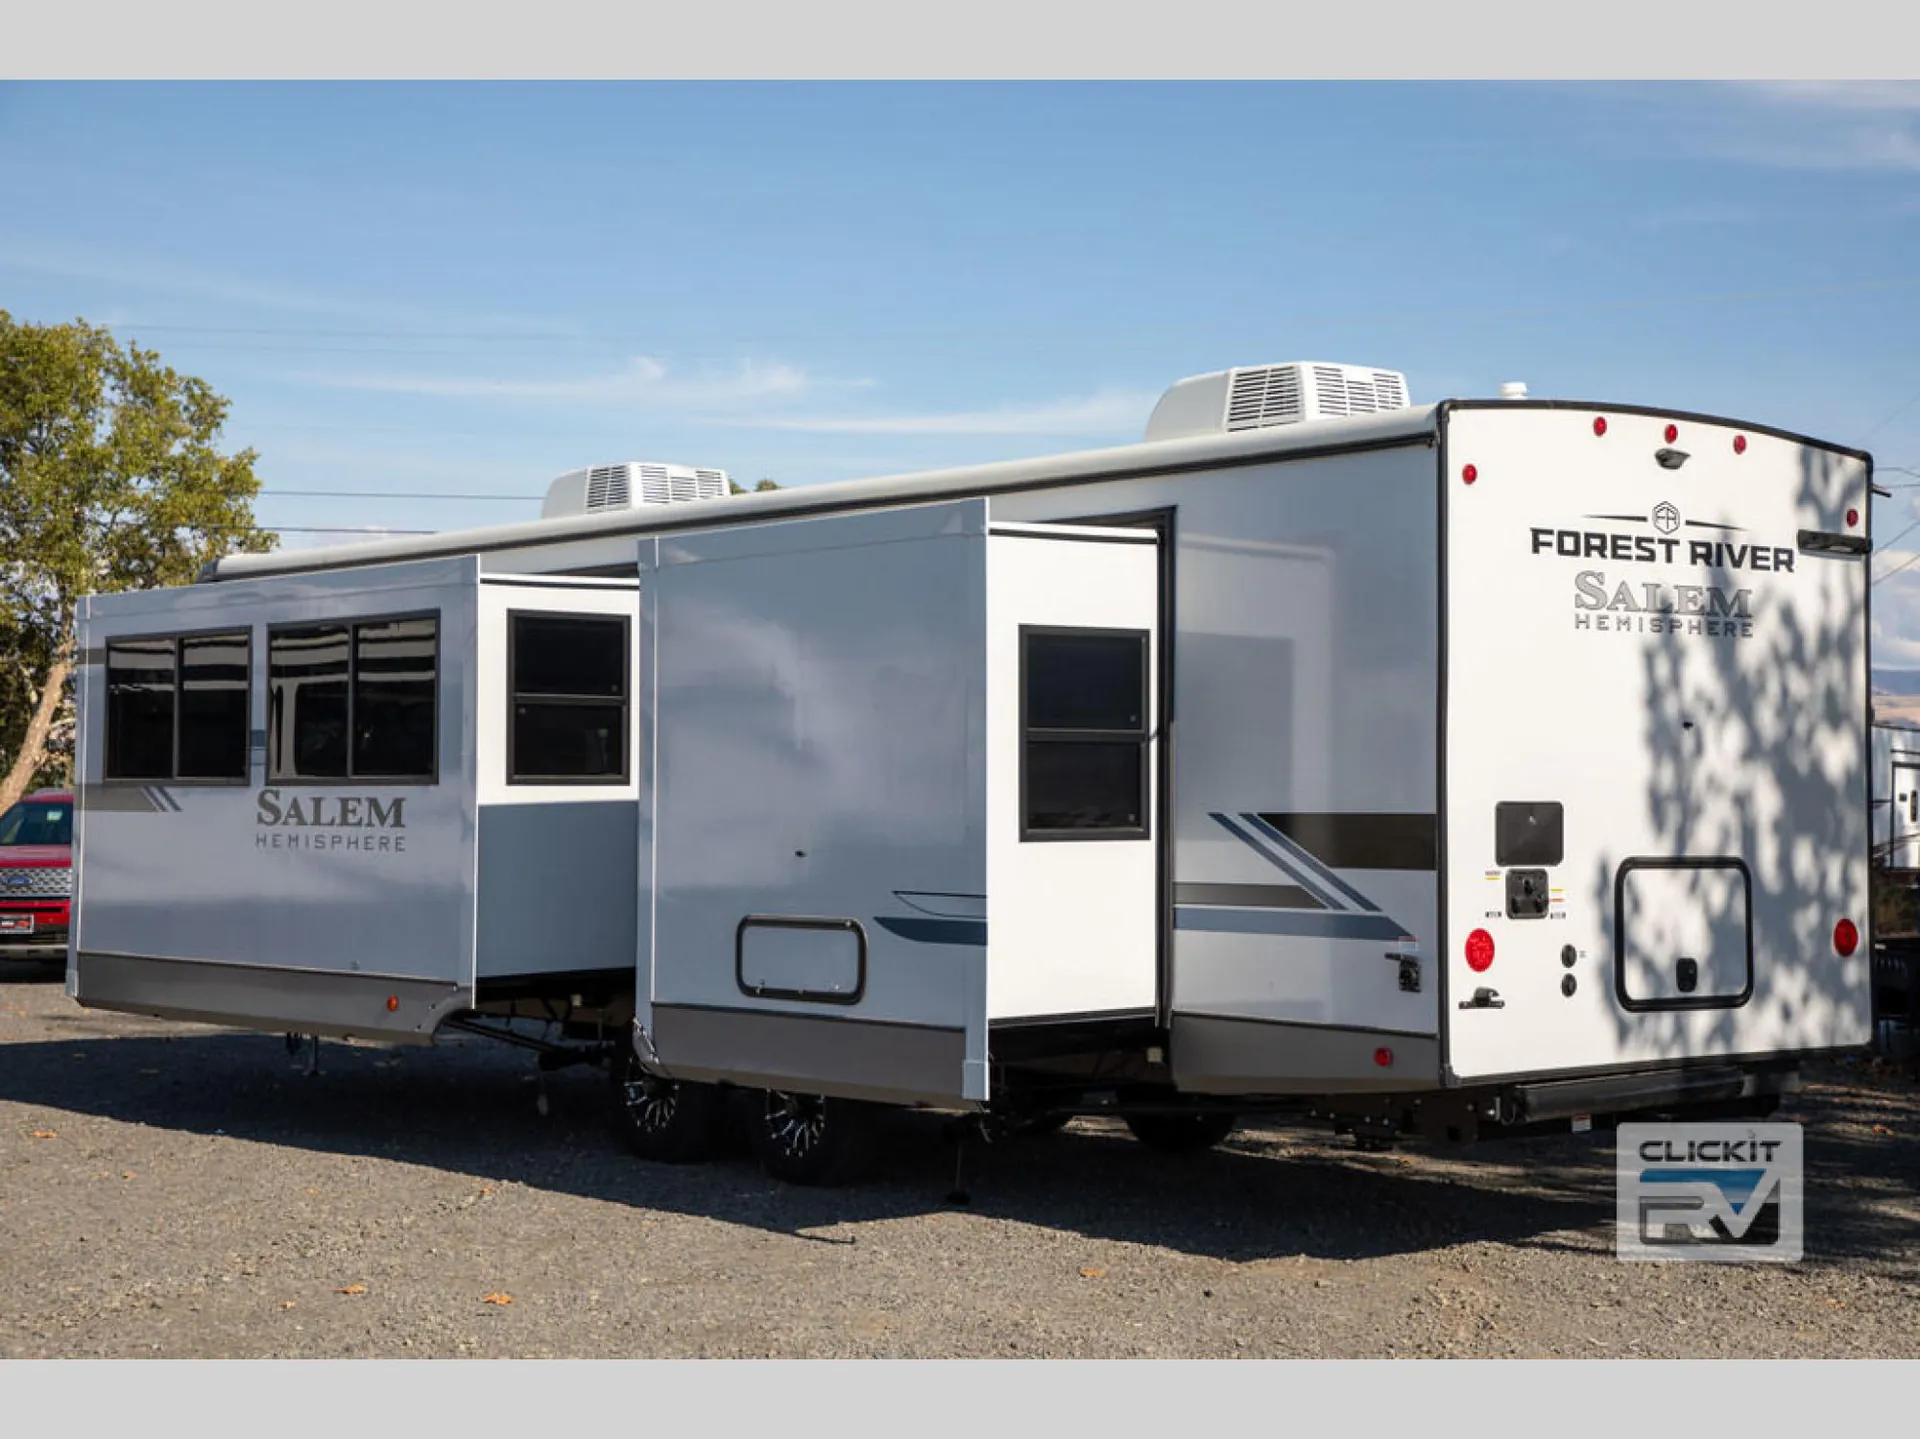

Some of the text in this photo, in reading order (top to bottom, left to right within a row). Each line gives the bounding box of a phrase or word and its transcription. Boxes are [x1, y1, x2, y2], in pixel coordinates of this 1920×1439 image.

[1530, 527, 1795, 573] FOREST RIVER
[1574, 570, 1754, 618] SALEM
[1574, 613, 1754, 638] HEMISPHERE
[256, 788, 406, 828] SALEM
[256, 832, 406, 852] HEMISPHERE
